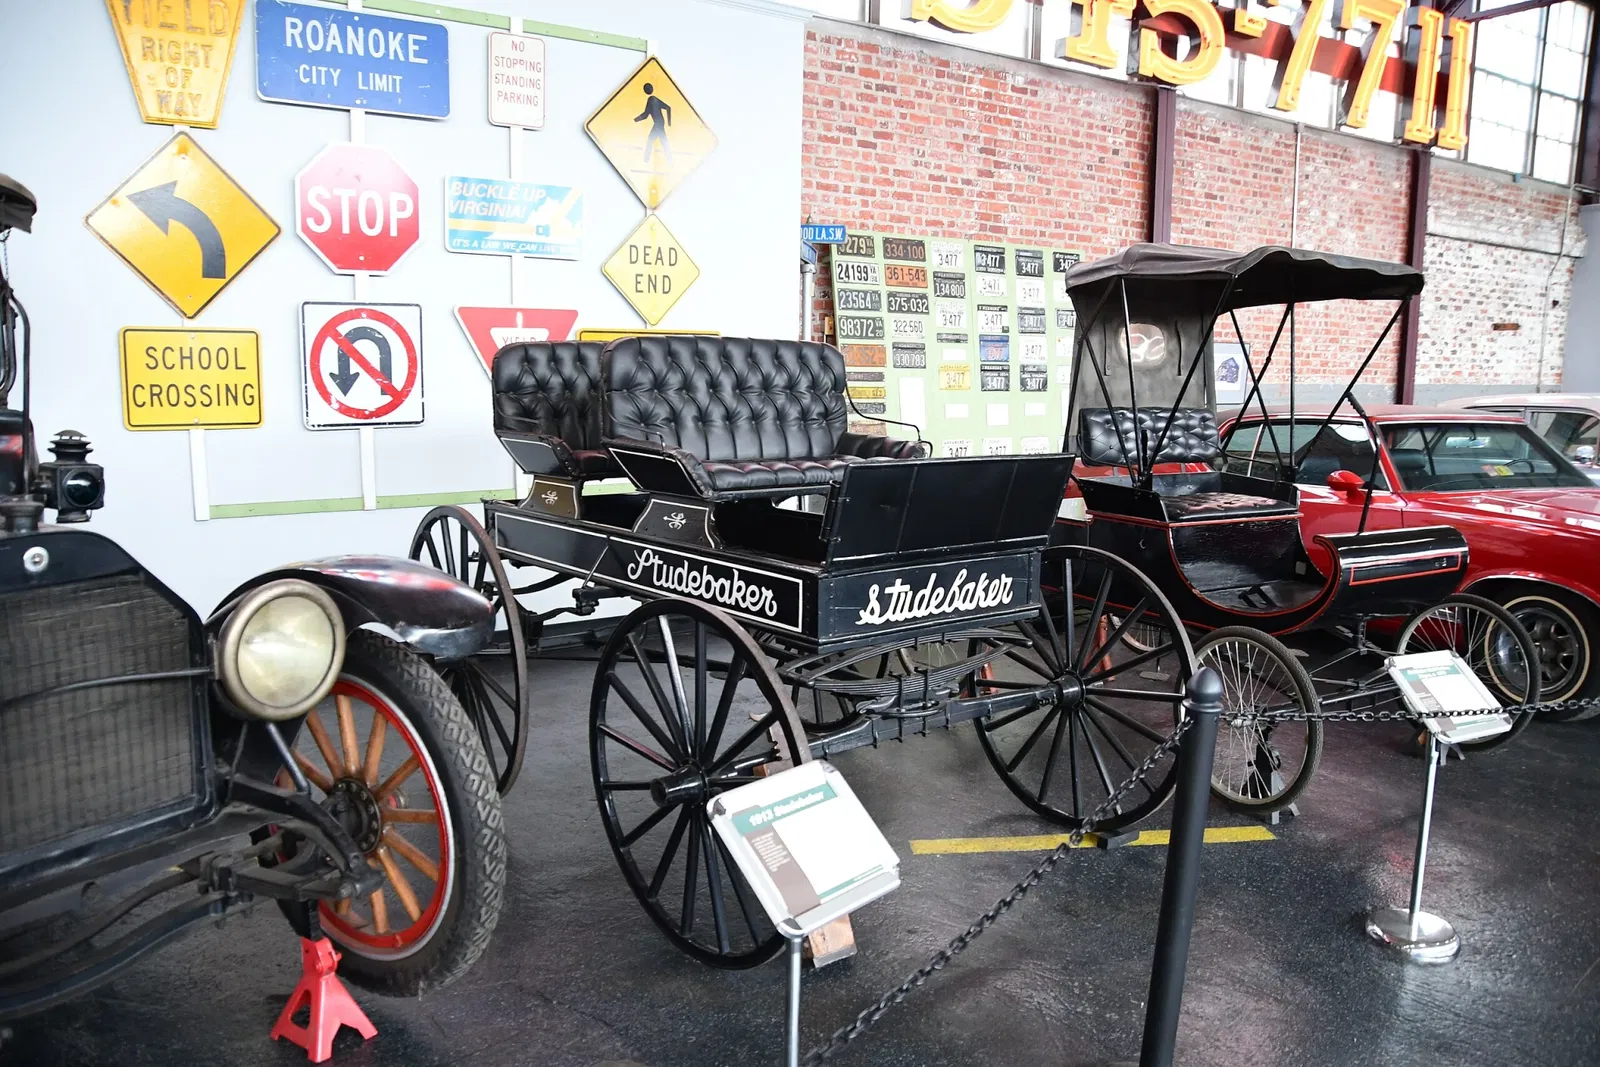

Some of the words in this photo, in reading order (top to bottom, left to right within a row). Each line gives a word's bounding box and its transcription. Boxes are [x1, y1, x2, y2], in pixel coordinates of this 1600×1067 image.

[118, 0, 231, 37] YIELD
[284, 16, 429, 65] ROANOKE
[510, 39, 525, 53] NO
[140, 36, 214, 69] RIGHT
[493, 55, 542, 74] STOPPING
[165, 66, 193, 89] OF
[298, 64, 341, 87] CITY
[357, 71, 403, 94] LIMIT
[493, 73, 541, 90] STANDING
[154, 89, 203, 117] WAY
[496, 90, 539, 107] PARKING
[450, 180, 517, 201] BUCKLE
[523, 188, 547, 203] UP
[305, 184, 414, 237] STOP
[518, 243, 538, 252] CAN
[628, 244, 678, 268] DEAD
[837, 262, 869, 282] 24199
[634, 273, 672, 295] END
[839, 290, 872, 310] 23564
[840, 318, 875, 337] 98372
[144, 345, 247, 372] SCHOOL
[132, 381, 256, 409] CROSSING
[627, 548, 778, 617] Studebaker
[855, 567, 1014, 627] Studebaker
